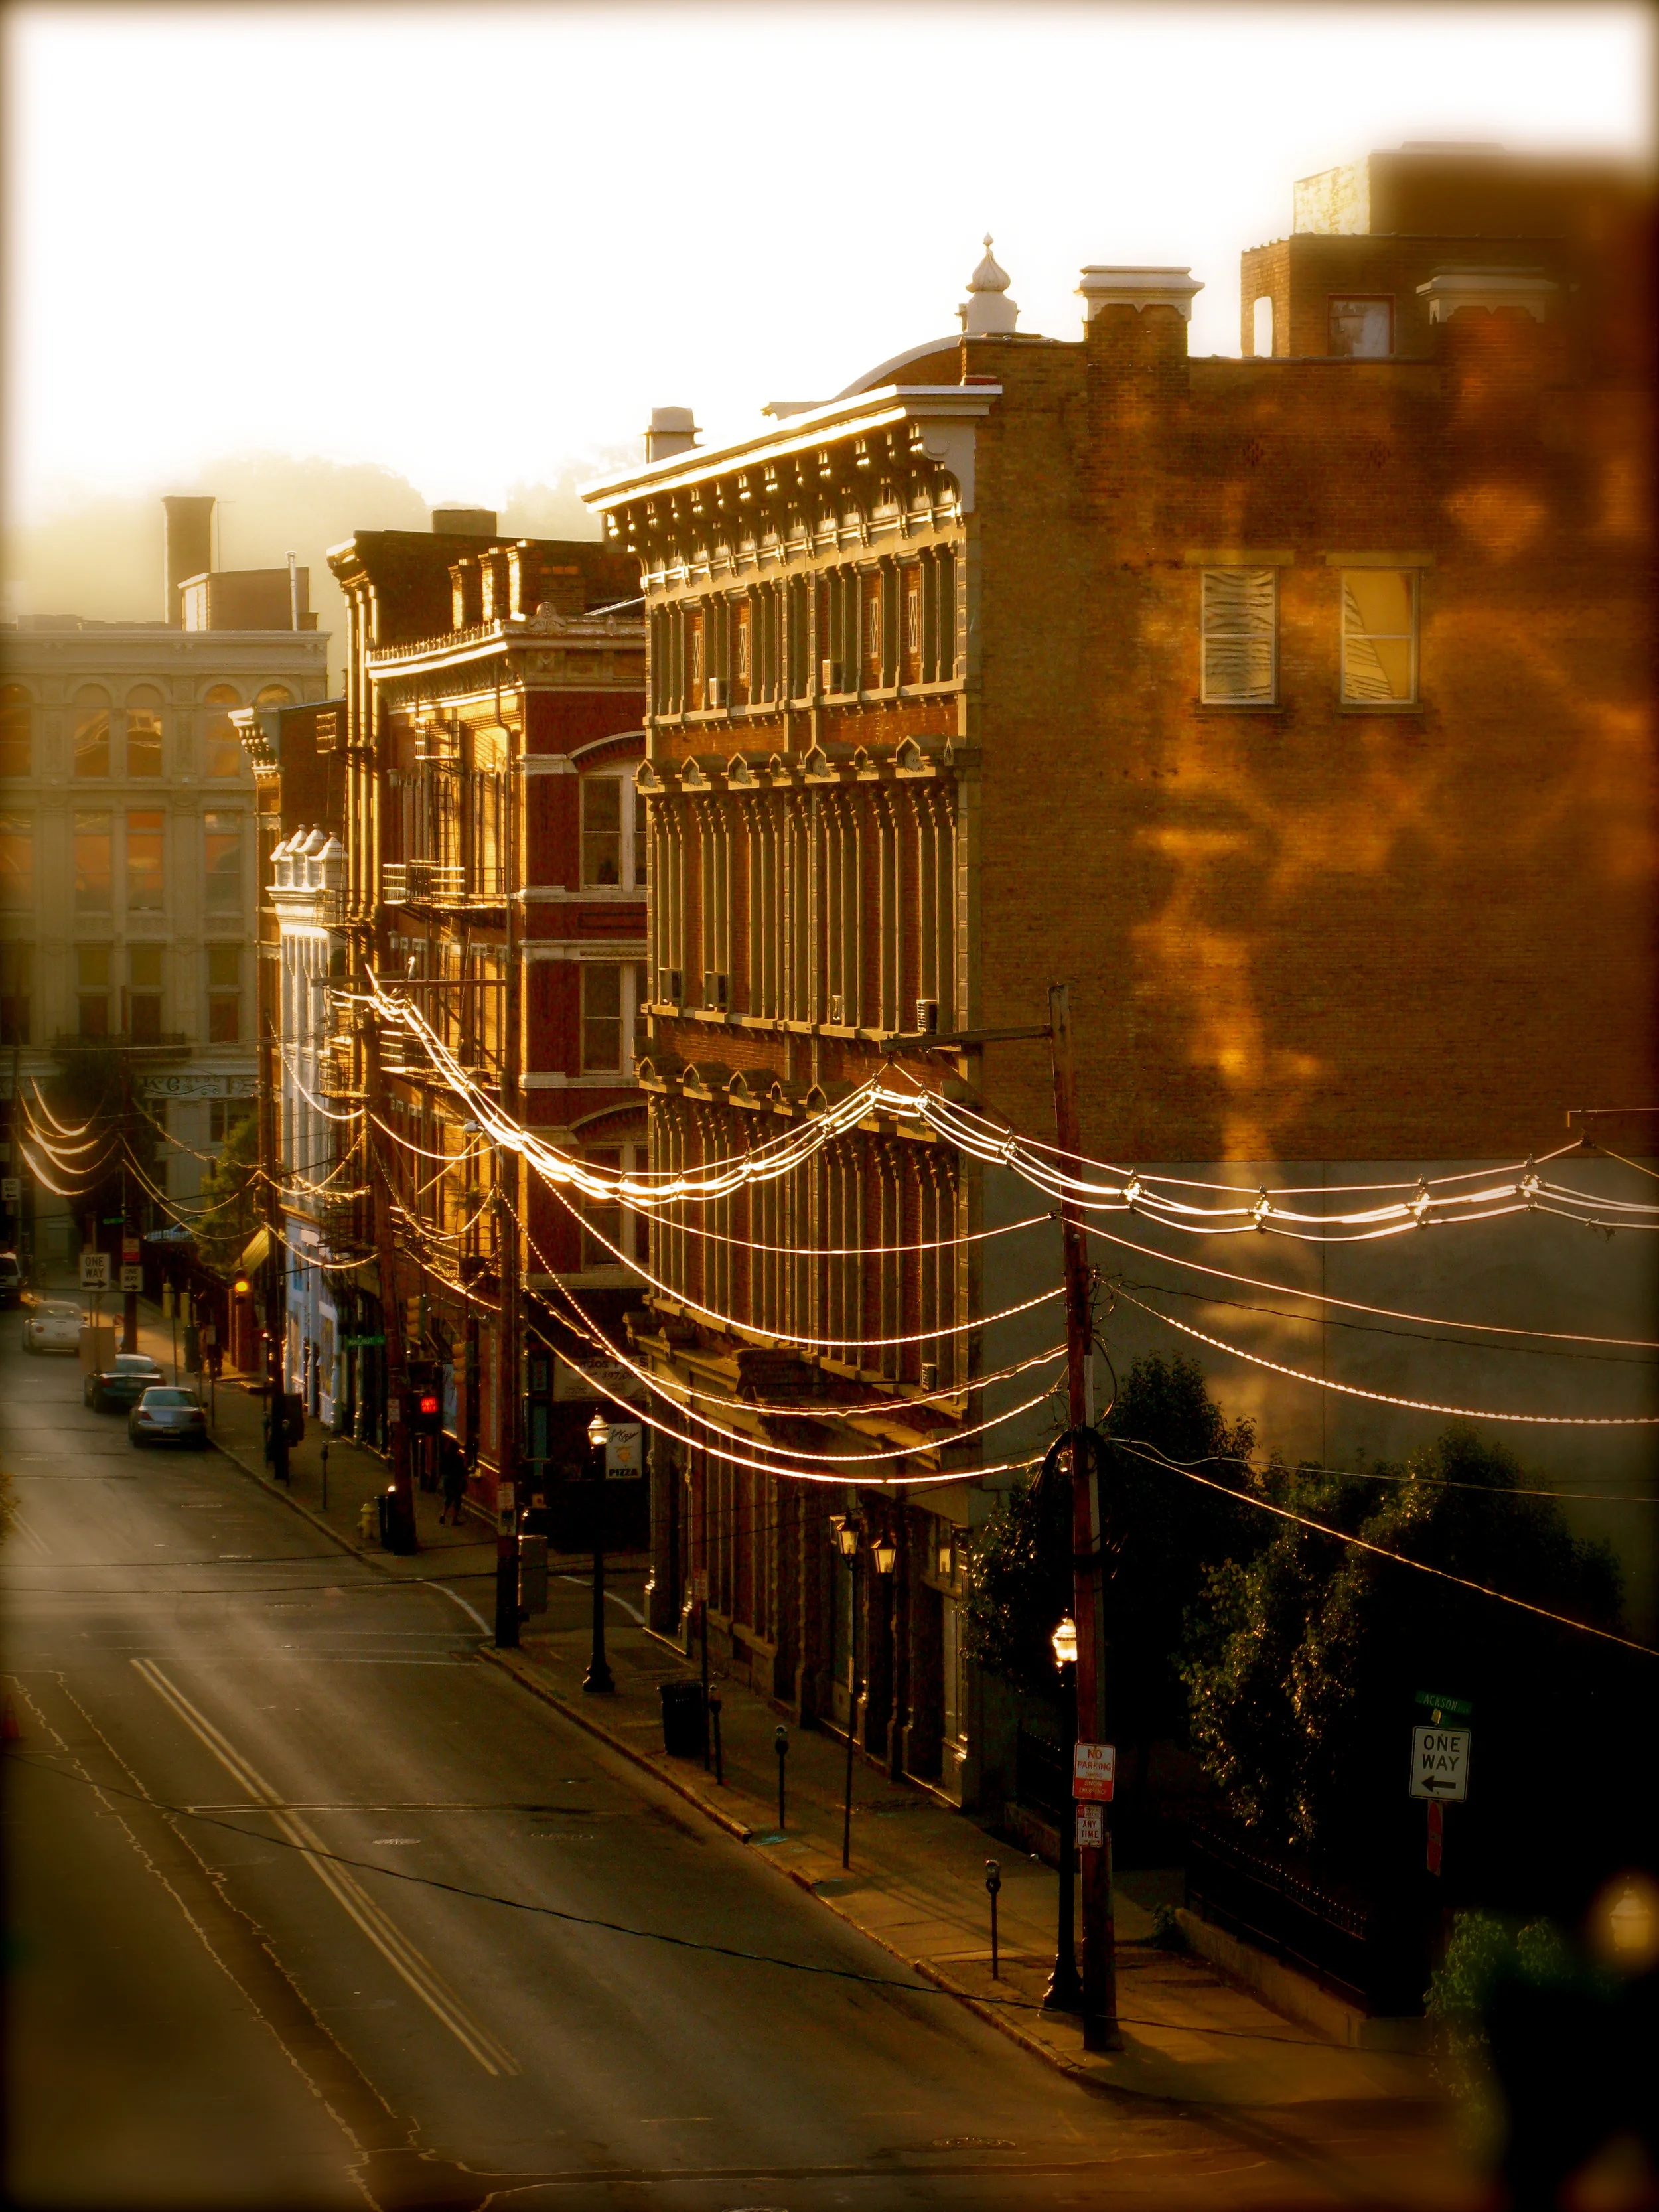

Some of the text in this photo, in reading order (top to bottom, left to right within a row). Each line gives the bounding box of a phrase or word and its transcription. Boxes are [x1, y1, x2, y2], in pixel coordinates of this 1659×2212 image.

[85, 1256, 104, 1267] ONE
[85, 1268, 104, 1278] WAY
[609, 1468, 638, 1477] PIZZA
[1423, 1735, 1461, 1752] ONE
[1088, 1749, 1102, 1759] NO
[1077, 1761, 1112, 1771] PARKING
[1422, 1754, 1459, 1771] WAY
